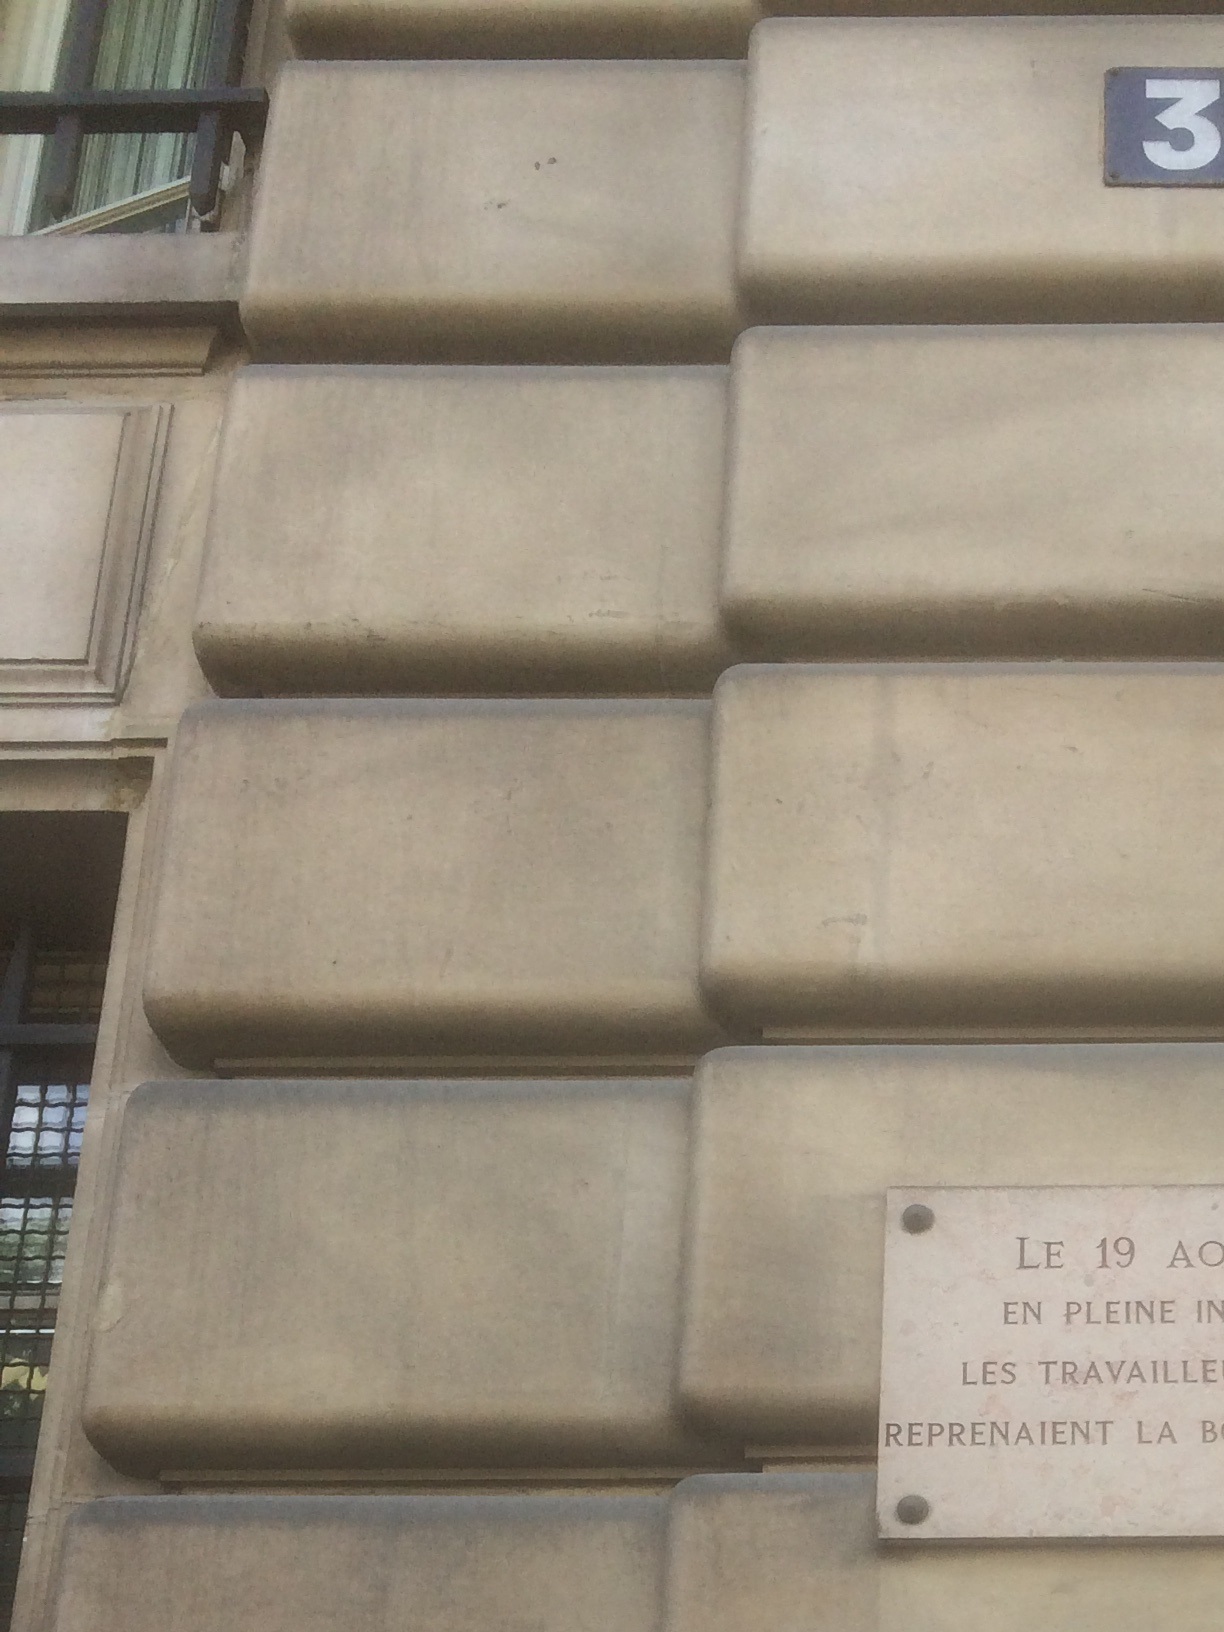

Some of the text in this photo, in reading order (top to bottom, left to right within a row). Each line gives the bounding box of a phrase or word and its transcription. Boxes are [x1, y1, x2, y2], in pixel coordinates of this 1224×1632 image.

[1142, 79, 1221, 170] 3
[1096, 1237, 1136, 1270] 19
[1003, 1301, 1042, 1325] EN
[1065, 1300, 1175, 1325] PLEINE
[961, 1361, 1016, 1386] LES
[885, 1421, 1113, 1447] REPRENAIENT
[1137, 1421, 1177, 1446] LA
